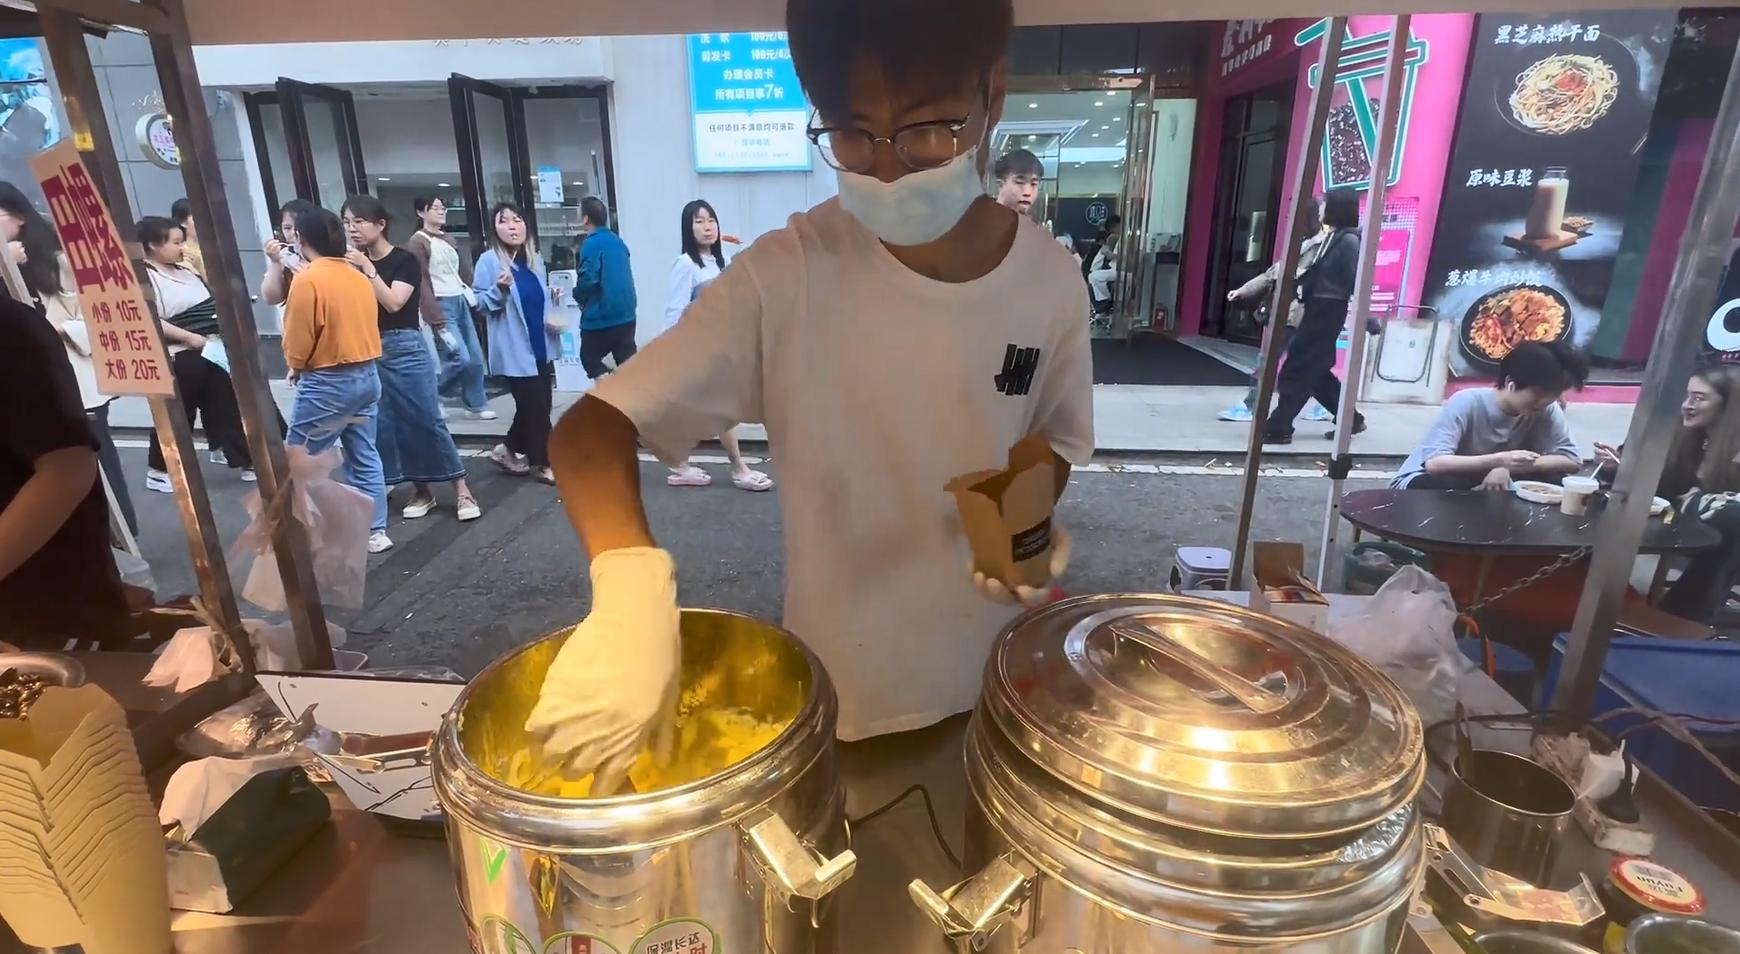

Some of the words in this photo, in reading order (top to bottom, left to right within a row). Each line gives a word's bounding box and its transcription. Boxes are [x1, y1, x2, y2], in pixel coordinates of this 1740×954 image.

[1494, 23, 1600, 45] 黑芝麻热干面
[723, 68, 774, 80] 办理会员卡
[1466, 168, 1533, 187] 原味豆浆
[41, 162, 134, 294] 田螺
[92, 302, 112, 323] 小份
[116, 300, 142, 322] 10元
[99, 330, 121, 352] 中份
[125, 330, 152, 351] 15元
[105, 359, 128, 380] 大份
[131, 359, 160, 380] 20元
